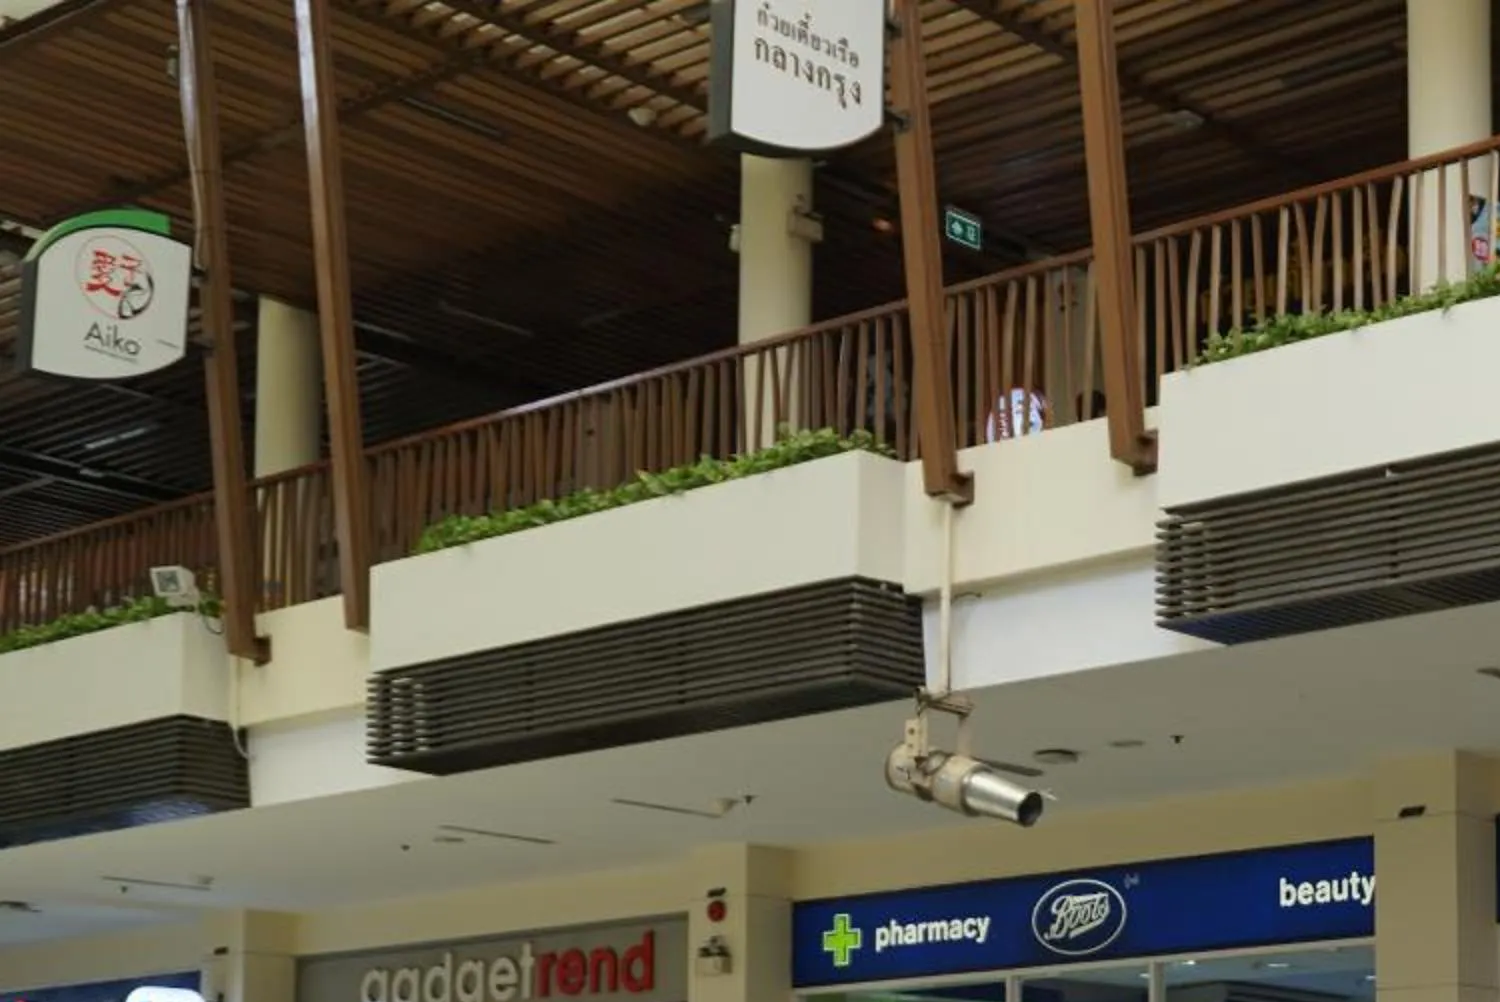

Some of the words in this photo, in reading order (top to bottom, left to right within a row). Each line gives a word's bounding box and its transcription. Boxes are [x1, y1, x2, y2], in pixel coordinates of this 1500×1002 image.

[754, 37, 862, 109] กลางกรุง
[84, 321, 142, 356] Aiko
[1279, 871, 1376, 907] beauty
[875, 916, 991, 952] pharmacy
[1043, 891, 1111, 941] Boots
